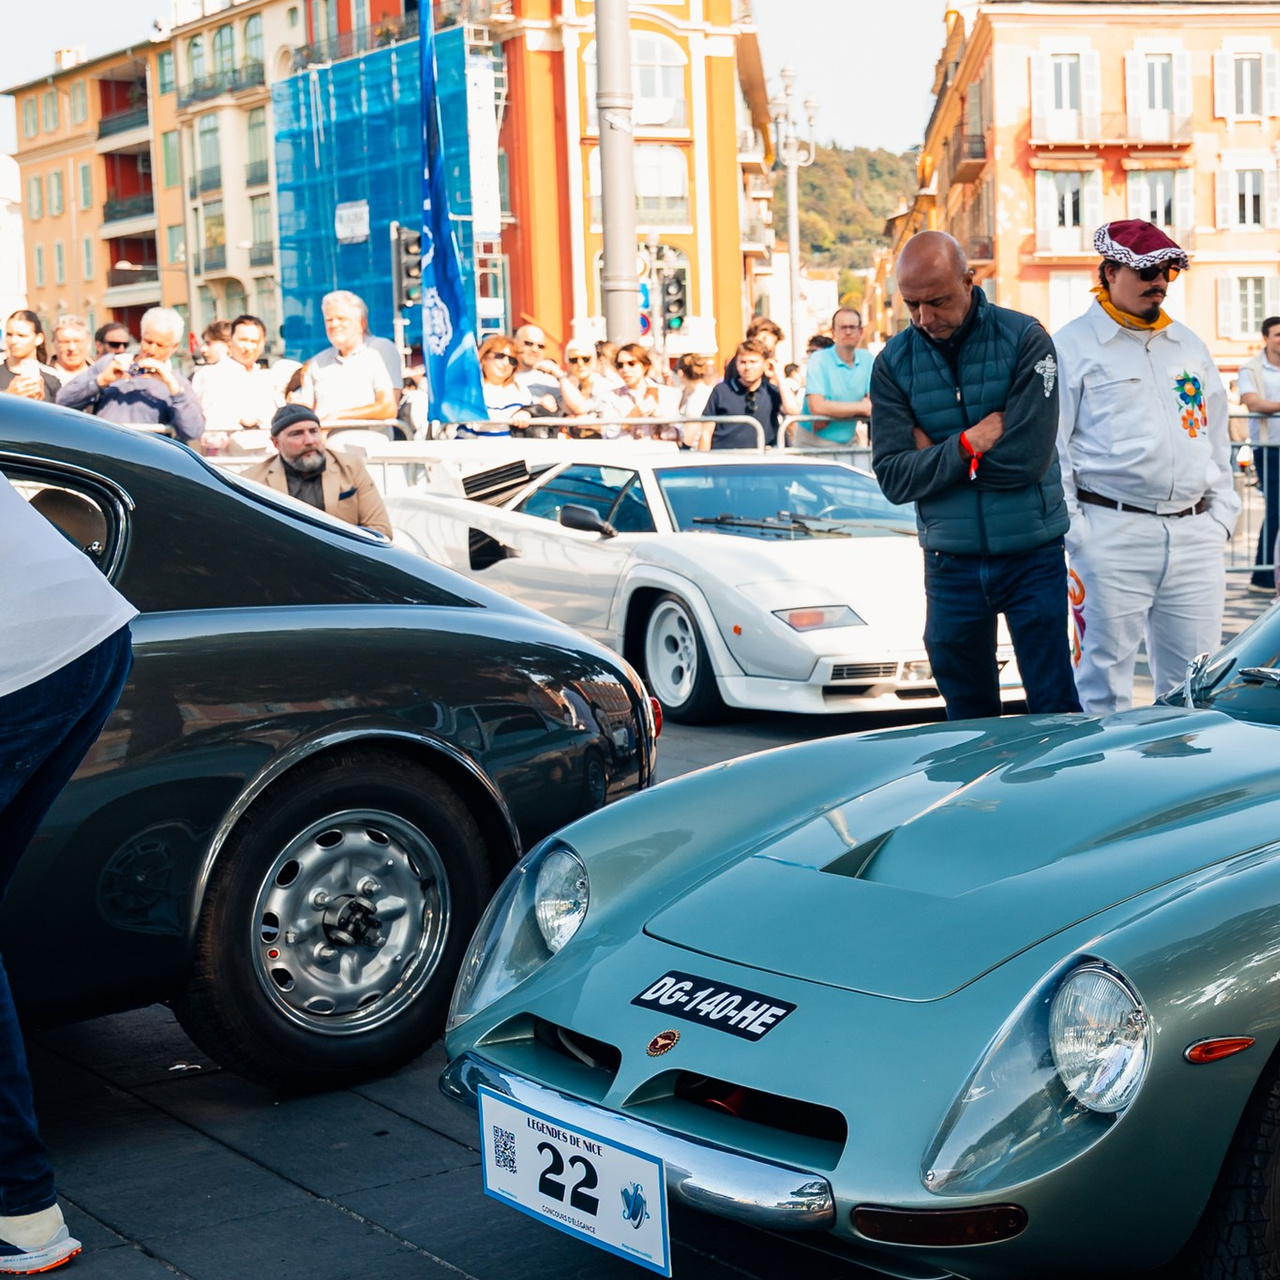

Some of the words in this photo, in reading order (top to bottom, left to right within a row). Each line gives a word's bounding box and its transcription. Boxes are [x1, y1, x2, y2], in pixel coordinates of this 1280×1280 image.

[640, 976, 787, 1035] DG-140-HE
[527, 1117, 568, 1143] LEGENDES
[569, 1134, 582, 1149] DE
[582, 1139, 603, 1157] NICE
[536, 1141, 600, 1217] 22
